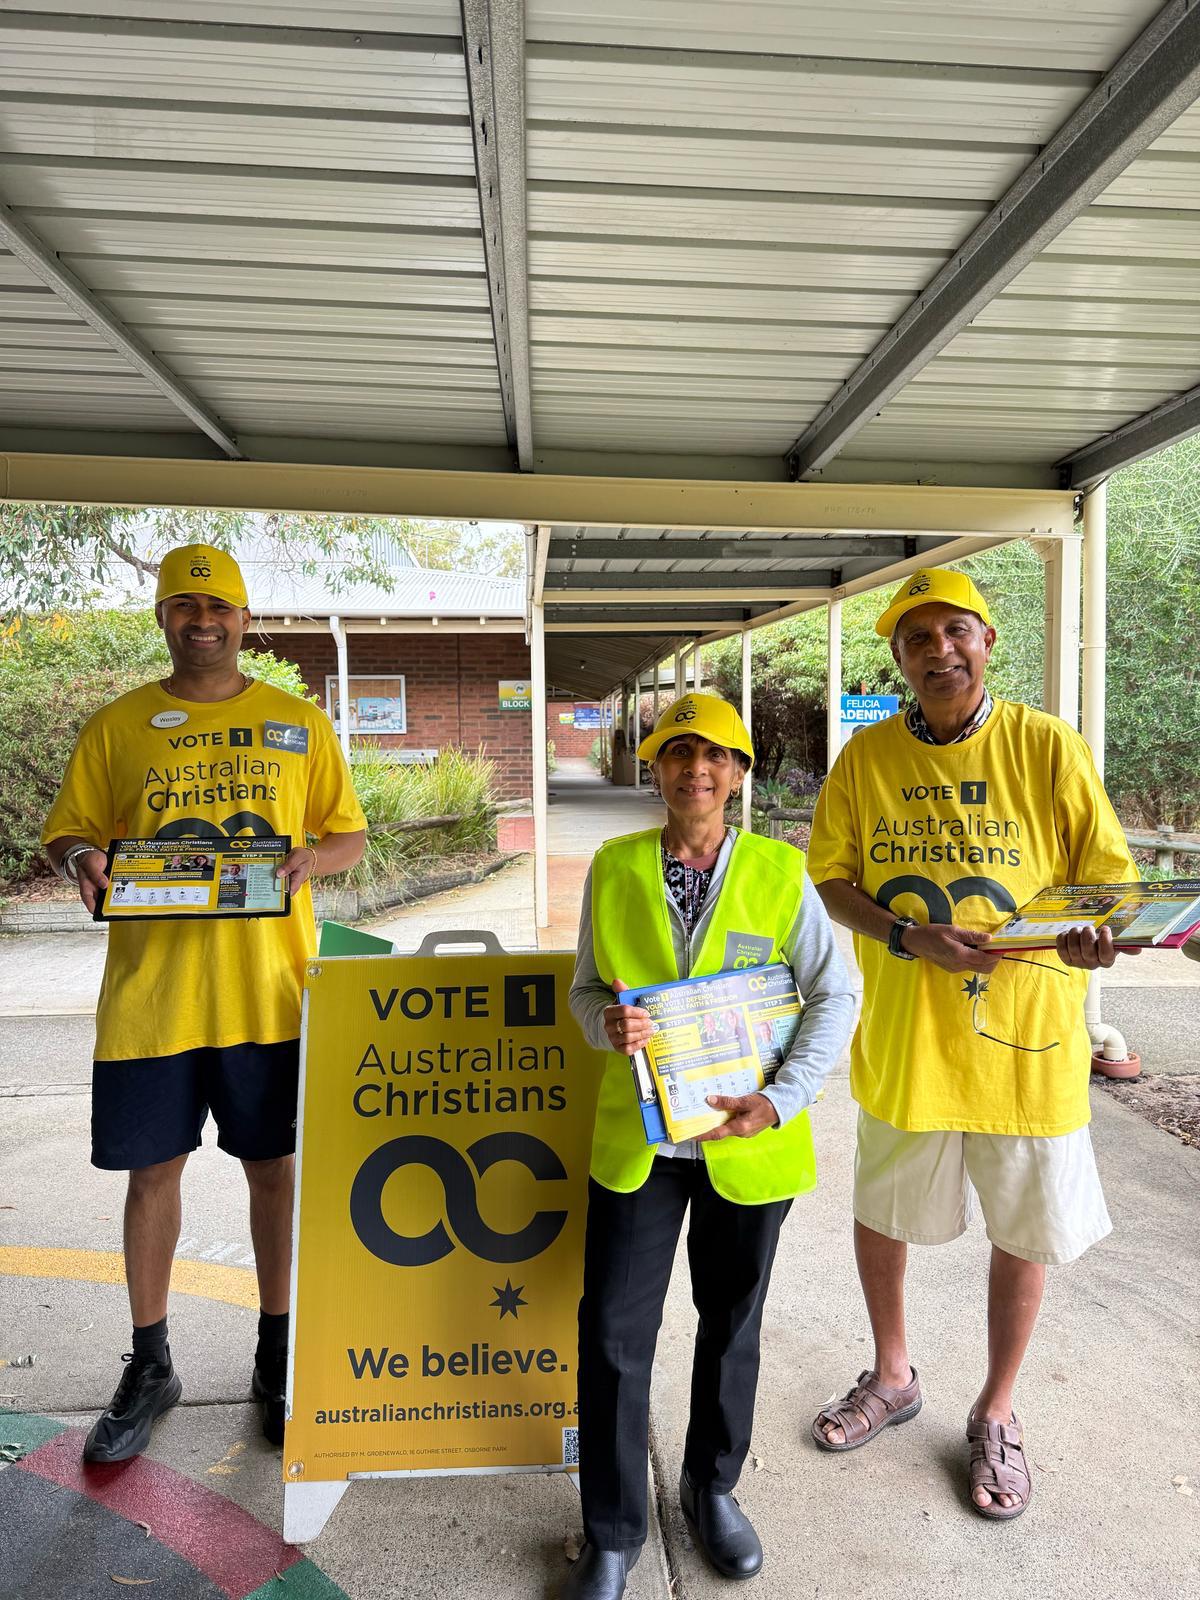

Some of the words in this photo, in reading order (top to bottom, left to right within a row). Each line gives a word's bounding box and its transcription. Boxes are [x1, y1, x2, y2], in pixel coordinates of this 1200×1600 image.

[846, 700, 880, 708] FELICIA
[168, 732, 223, 749] VOTE
[145, 754, 280, 789] Australian
[147, 780, 277, 812] Christians
[901, 785, 953, 801] VOTE
[872, 814, 1020, 838] Australian
[870, 841, 1021, 867] Christians
[767, 972, 791, 981] Australian
[768, 979, 793, 987] Christians
[368, 986, 489, 1021] VOTE
[644, 995, 660, 1003] Vote
[355, 1038, 565, 1076] Australian
[353, 1079, 566, 1117] Christians
[347, 1347, 409, 1379] We
[422, 1343, 568, 1377] believe.
